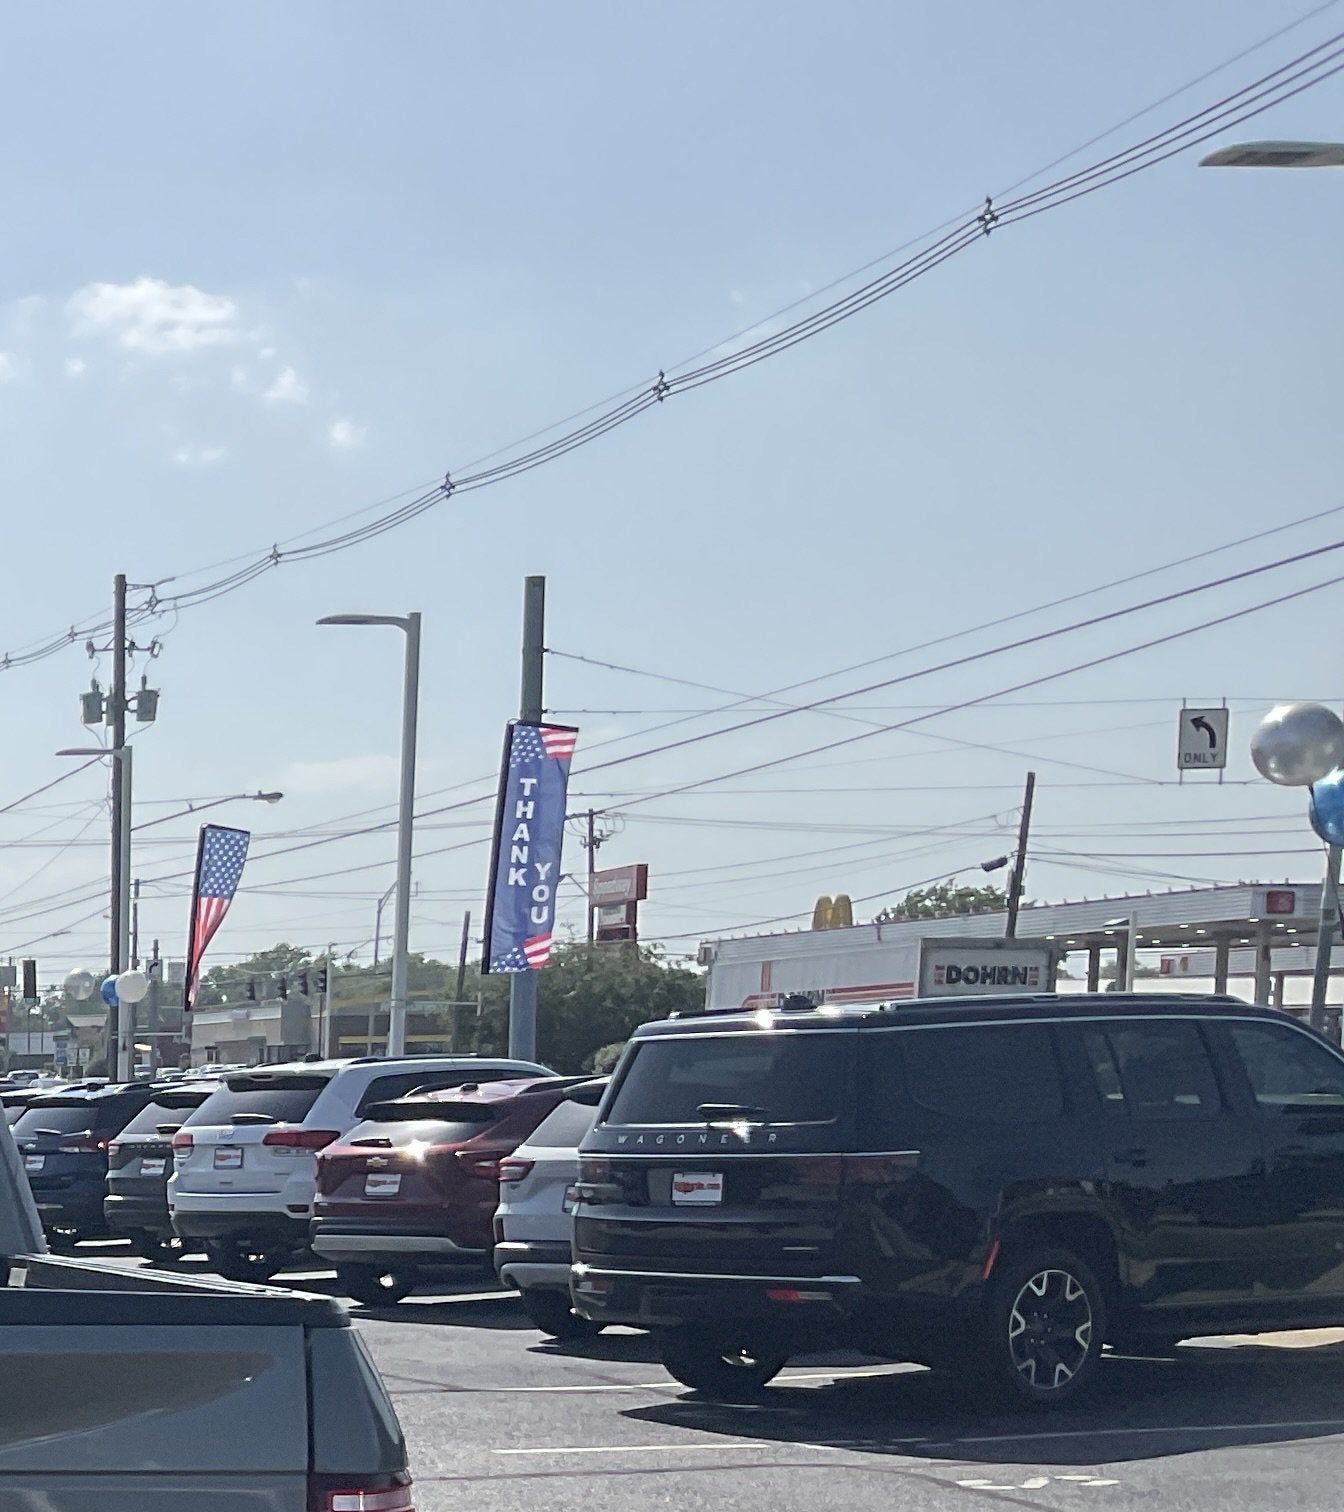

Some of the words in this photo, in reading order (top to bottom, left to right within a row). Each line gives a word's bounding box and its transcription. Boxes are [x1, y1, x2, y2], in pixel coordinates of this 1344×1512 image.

[1183, 752, 1219, 764] ONLY
[508, 778, 537, 886] THANK
[530, 862, 552, 924] YOU
[945, 964, 1028, 985] DOHRN
[617, 1133, 777, 1144] WAGONEER
